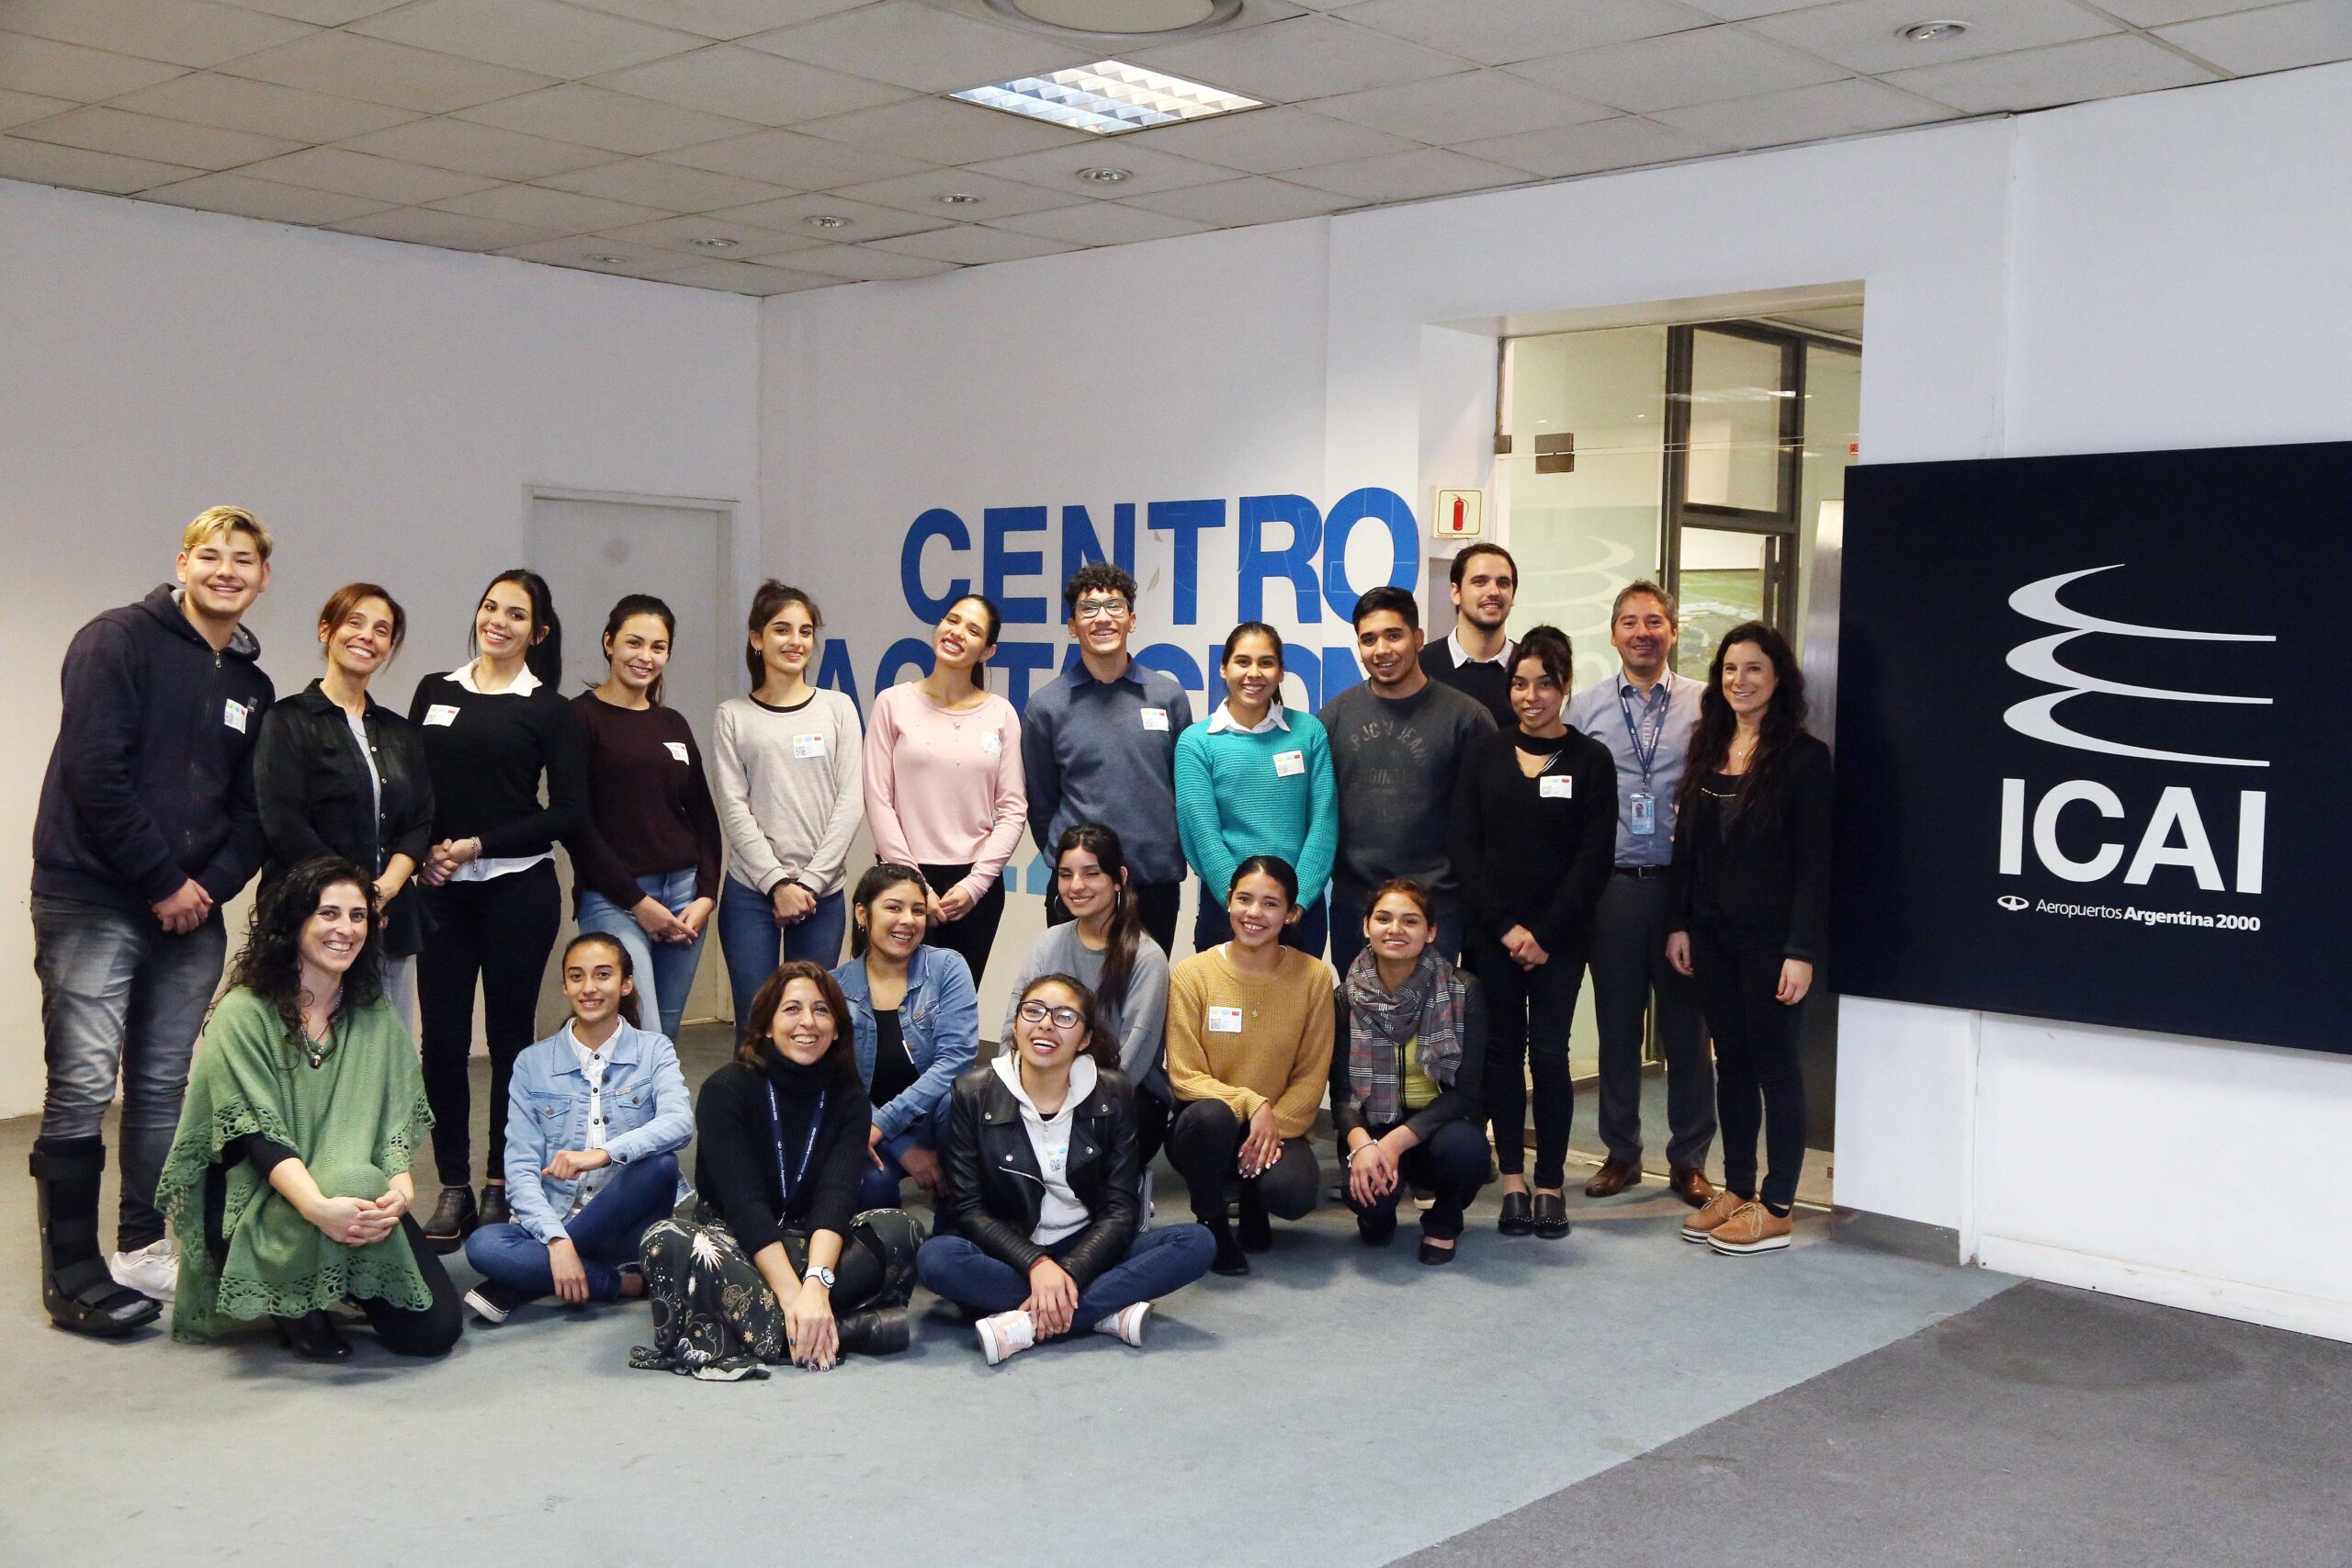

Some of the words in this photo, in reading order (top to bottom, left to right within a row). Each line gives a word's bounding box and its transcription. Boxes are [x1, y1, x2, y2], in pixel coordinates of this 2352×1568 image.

[902, 487, 1419, 626] CENTRO
[2000, 778, 2266, 894] ICAI
[2036, 898, 2122, 919] Aeropuertos
[2123, 906, 2214, 926] Argentina
[2215, 914, 2261, 931] 2000
